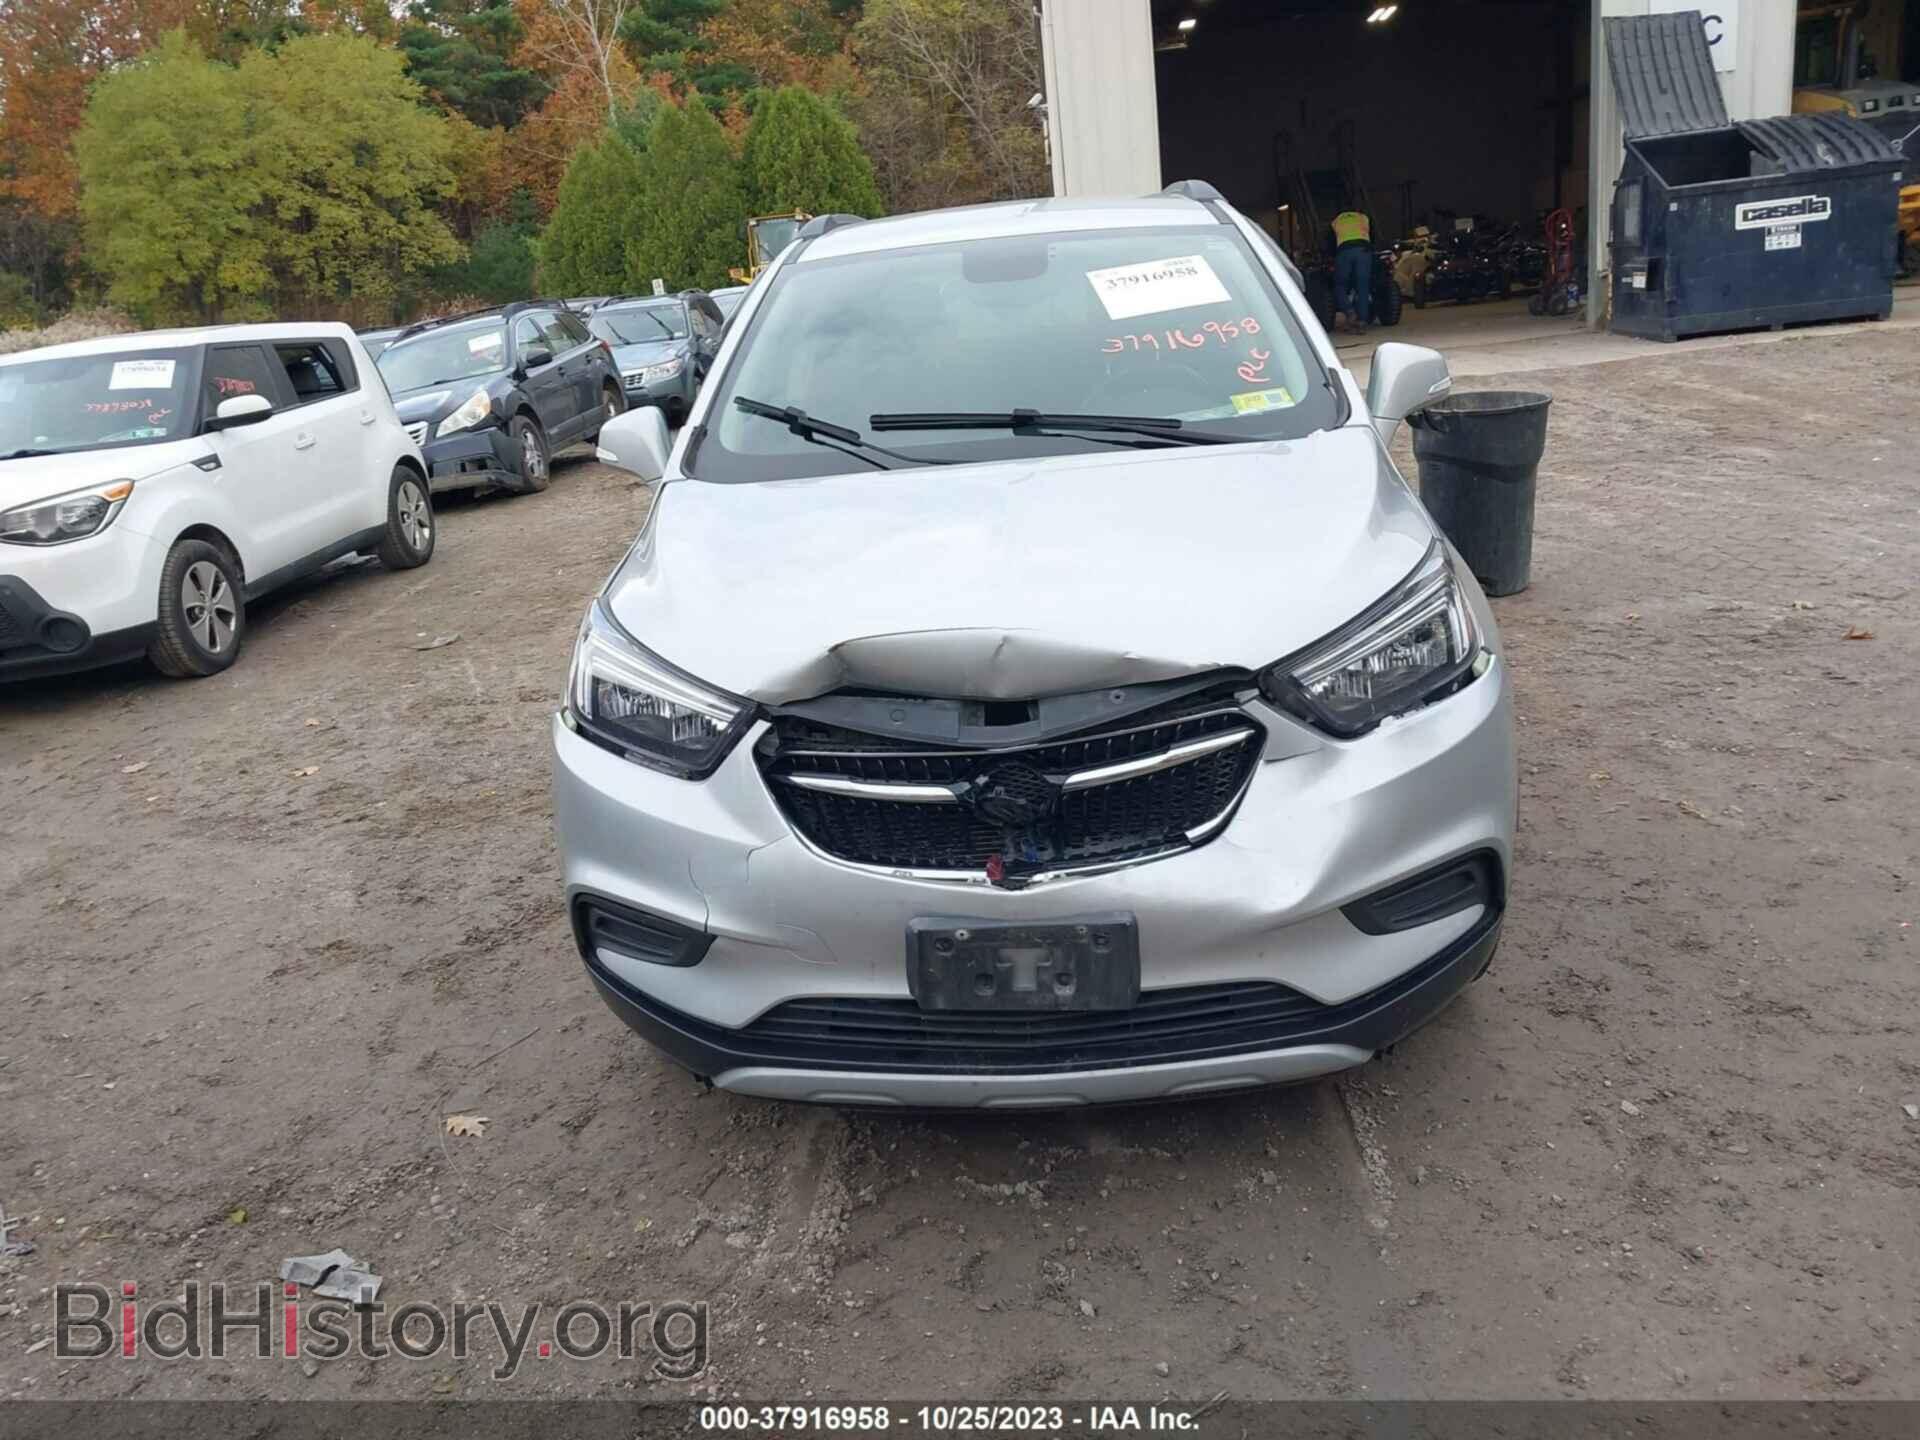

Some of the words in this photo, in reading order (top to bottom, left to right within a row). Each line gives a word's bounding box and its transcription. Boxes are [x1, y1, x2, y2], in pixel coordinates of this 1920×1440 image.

[1702, 14, 1723, 46] C
[1742, 197, 1828, 222] casella
[1105, 266, 1199, 290] 37916958
[1101, 317, 1262, 353] 37916958
